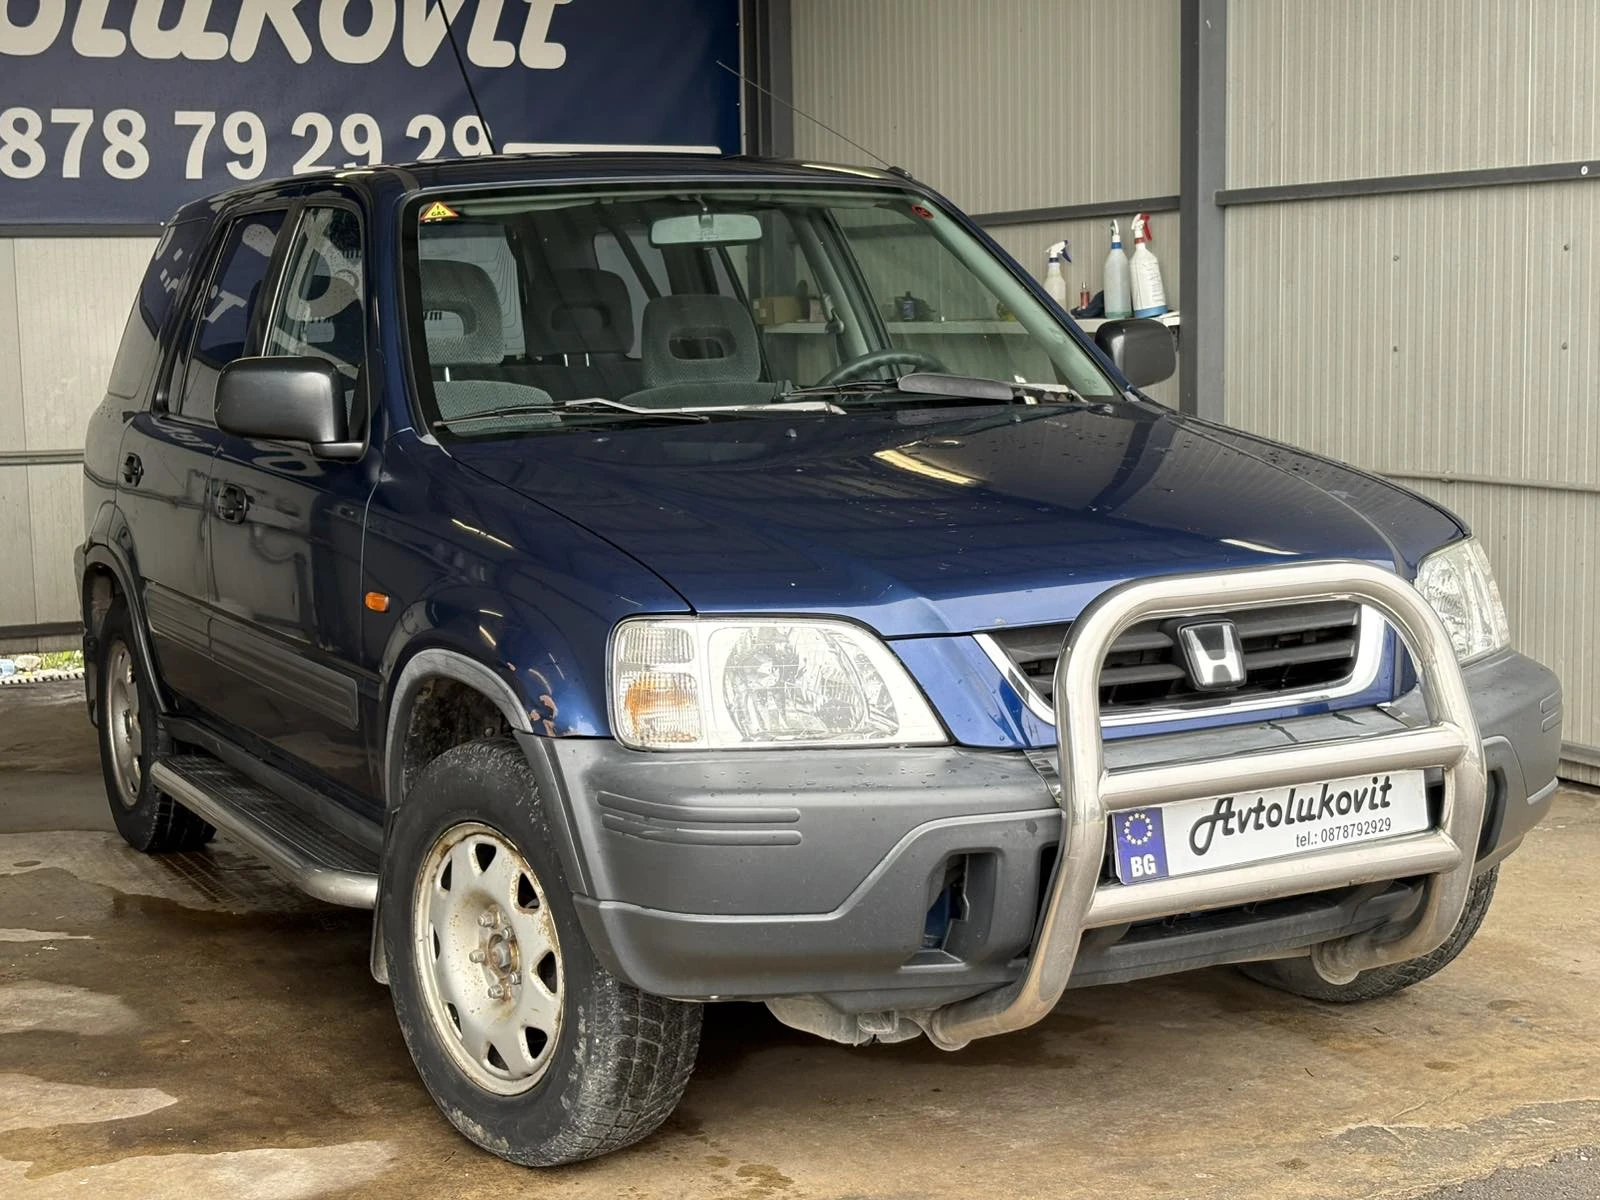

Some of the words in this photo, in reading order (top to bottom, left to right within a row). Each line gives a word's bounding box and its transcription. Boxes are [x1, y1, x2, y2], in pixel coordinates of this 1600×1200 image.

[0, 107, 149, 180] 878
[174, 110, 267, 180] 79
[292, 112, 382, 175] 29
[1189, 775, 1392, 856] Avtolukovit
[1296, 831, 1317, 847] tel.:
[1321, 817, 1391, 843] 0878792929
[1130, 853, 1157, 877] BG
